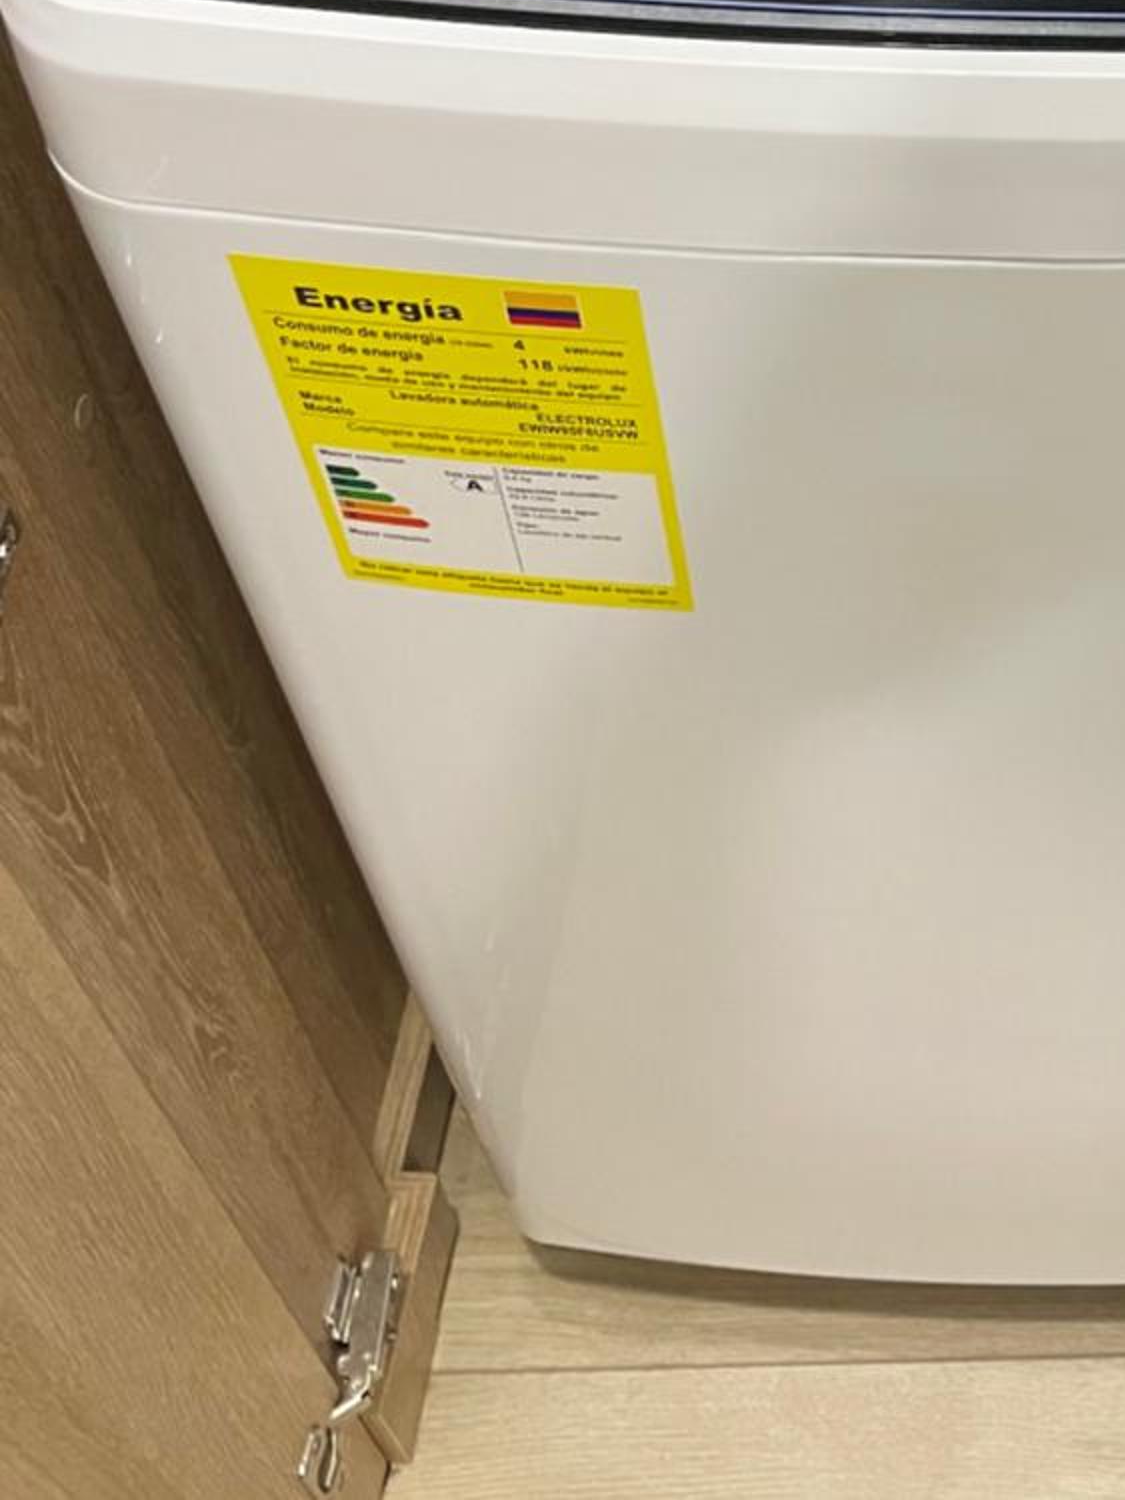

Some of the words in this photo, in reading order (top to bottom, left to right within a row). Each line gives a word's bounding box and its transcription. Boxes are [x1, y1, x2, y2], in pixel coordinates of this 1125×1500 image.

[293, 286, 465, 322] Energía
[272, 315, 354, 337] Consumo
[357, 325, 378, 339] de
[278, 335, 332, 351] Factor
[336, 342, 357, 356] de
[513, 339, 526, 351] 4
[519, 358, 553, 372] 118
[298, 389, 343, 404] Marca
[388, 389, 457, 406] Lavadora
[302, 401, 356, 417] Modelo
[535, 412, 637, 428] ELECTROLUX
[466, 479, 484, 493] A
